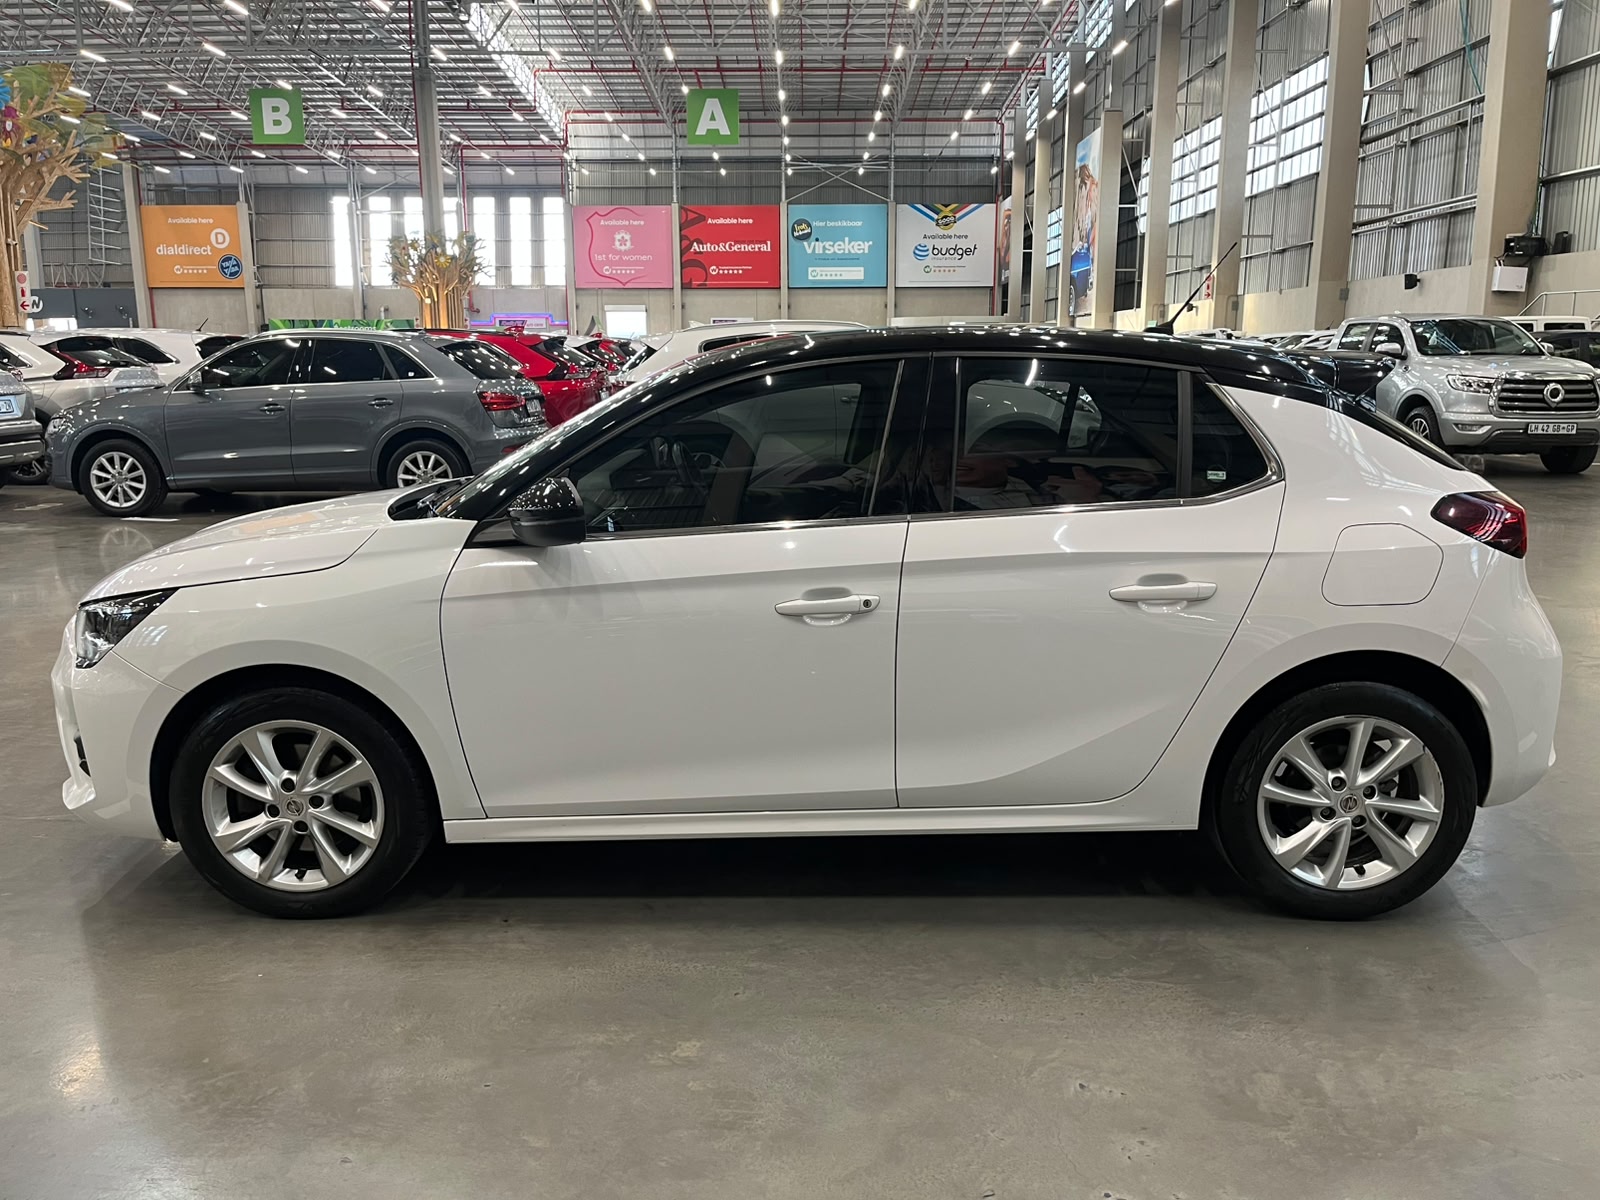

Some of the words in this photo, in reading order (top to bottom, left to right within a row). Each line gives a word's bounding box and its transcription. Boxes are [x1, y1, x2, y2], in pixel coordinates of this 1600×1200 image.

[261, 97, 292, 135] B
[695, 98, 730, 136] A
[156, 244, 212, 255] dialdirect
[690, 241, 771, 252] Auto&General
[803, 236, 873, 254] virseker
[931, 244, 978, 261] budget
[594, 253, 606, 261] 1st
[608, 253, 620, 261] for
